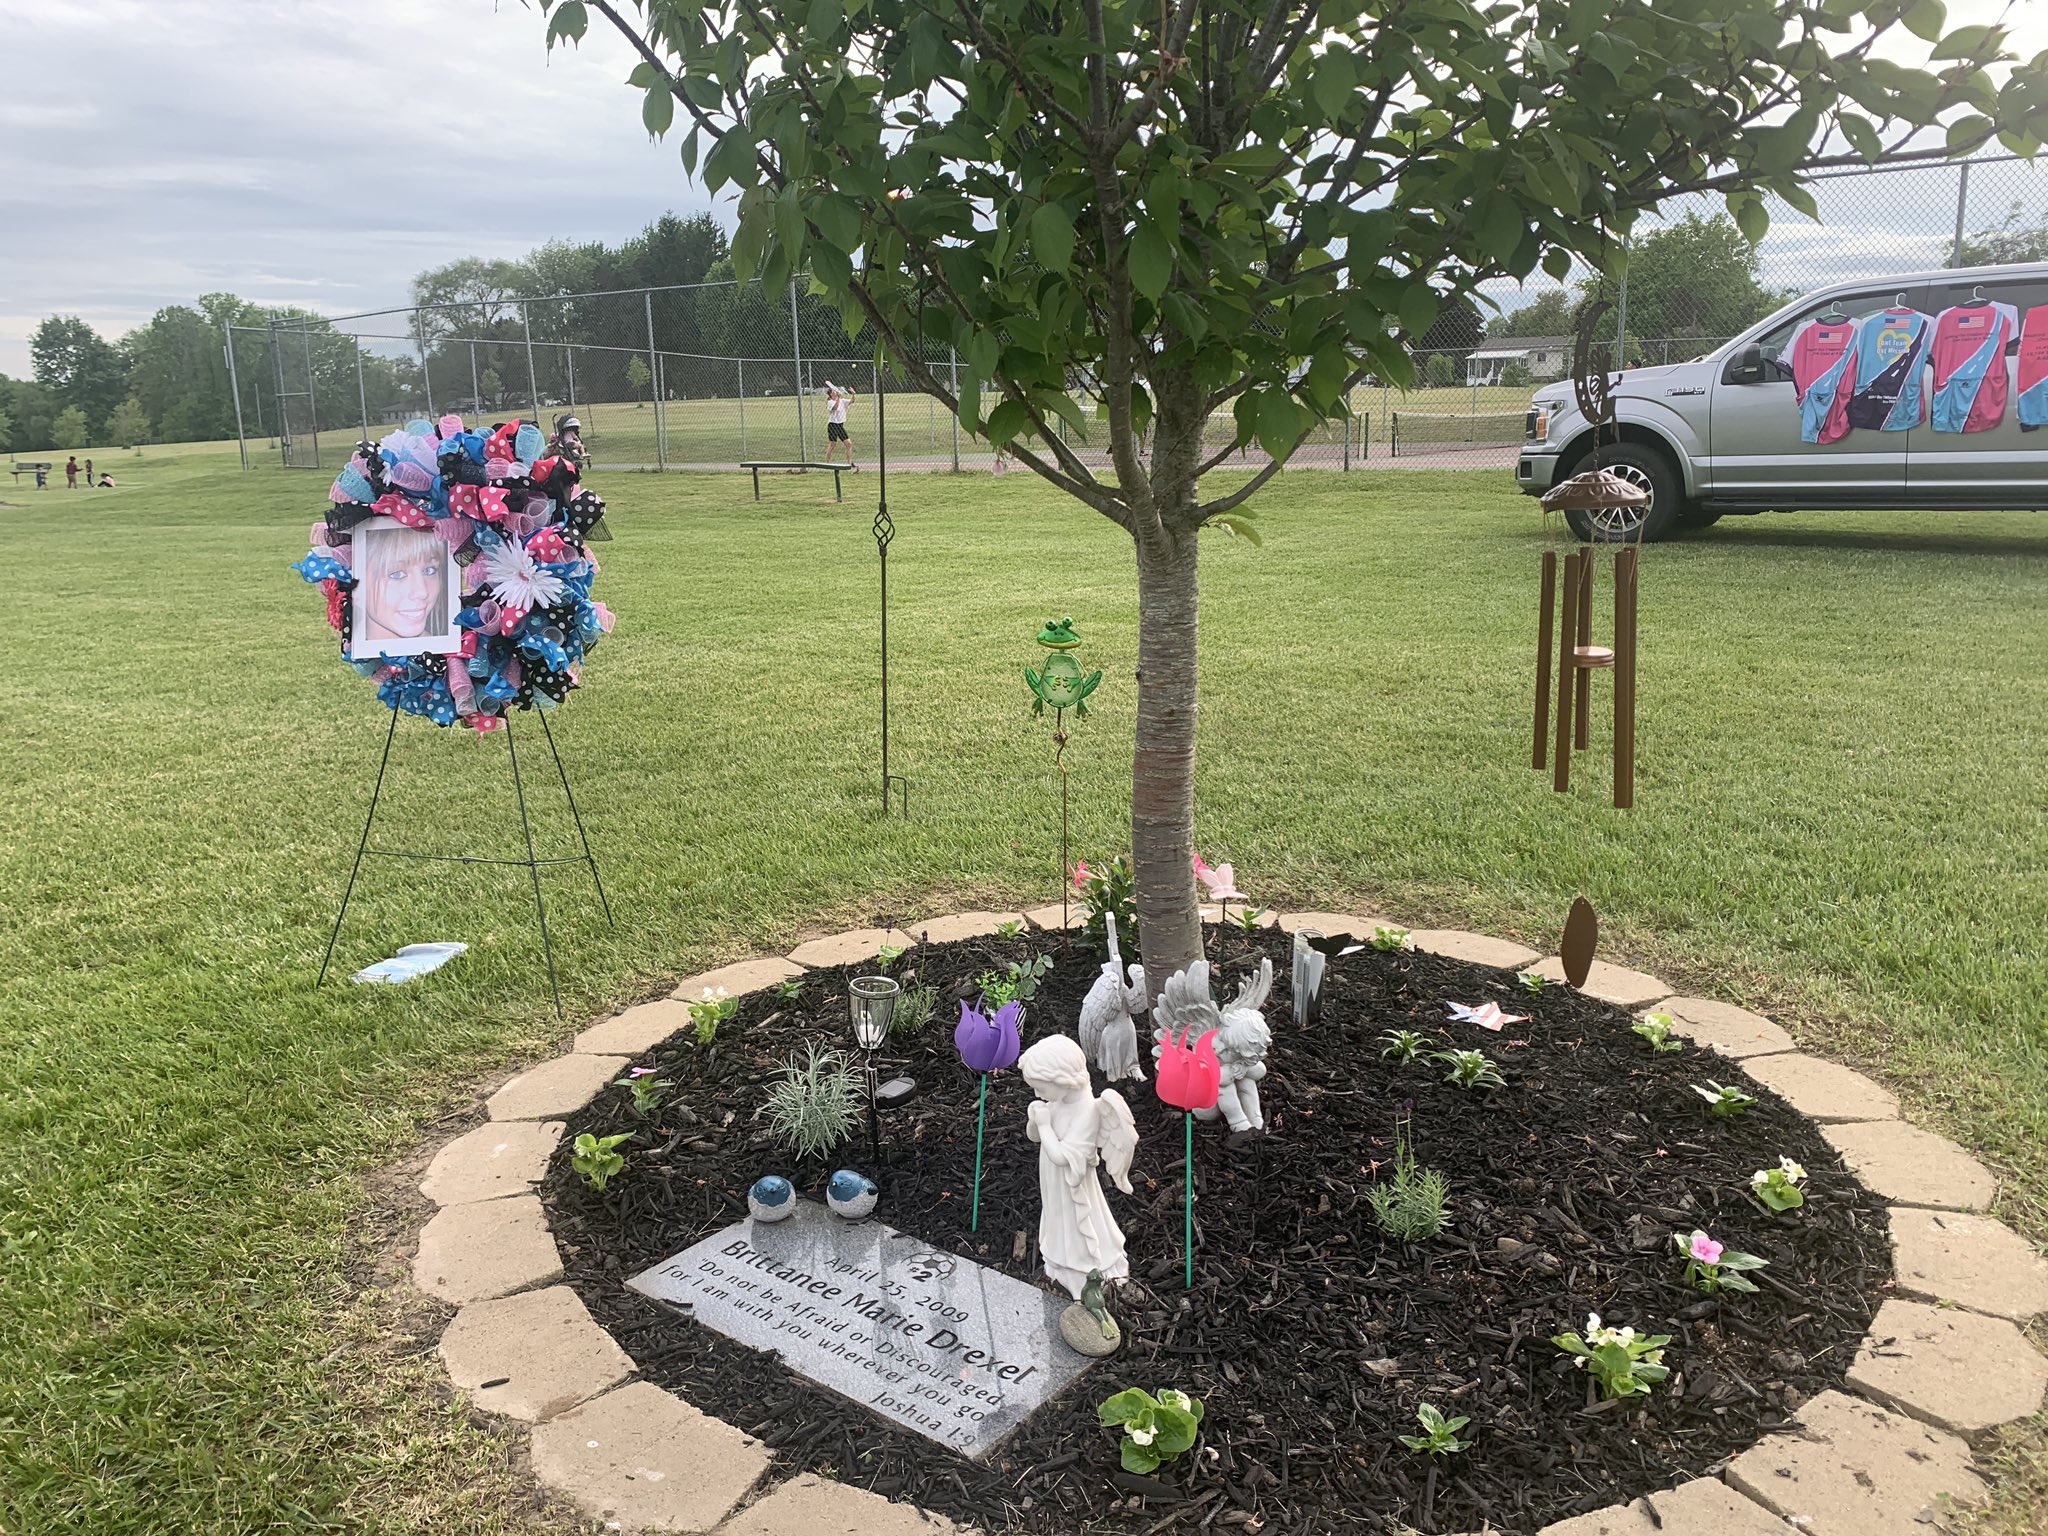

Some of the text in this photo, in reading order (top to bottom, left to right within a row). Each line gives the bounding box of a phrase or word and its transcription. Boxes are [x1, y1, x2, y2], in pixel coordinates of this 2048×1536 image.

[721, 1240, 1036, 1386] Brittanee Marie Drexel
[824, 1257, 970, 1324] April 25, 2009
[909, 1265, 933, 1283] #2
[658, 1264, 985, 1423] for I am with you wherever you go
[726, 1274, 758, 1293] not
[761, 1288, 782, 1305] be
[785, 1301, 850, 1334] Afraid
[849, 1330, 874, 1346] or
[874, 1341, 1005, 1406] Discouraged
[869, 1391, 977, 1448] Joshua 1:9
